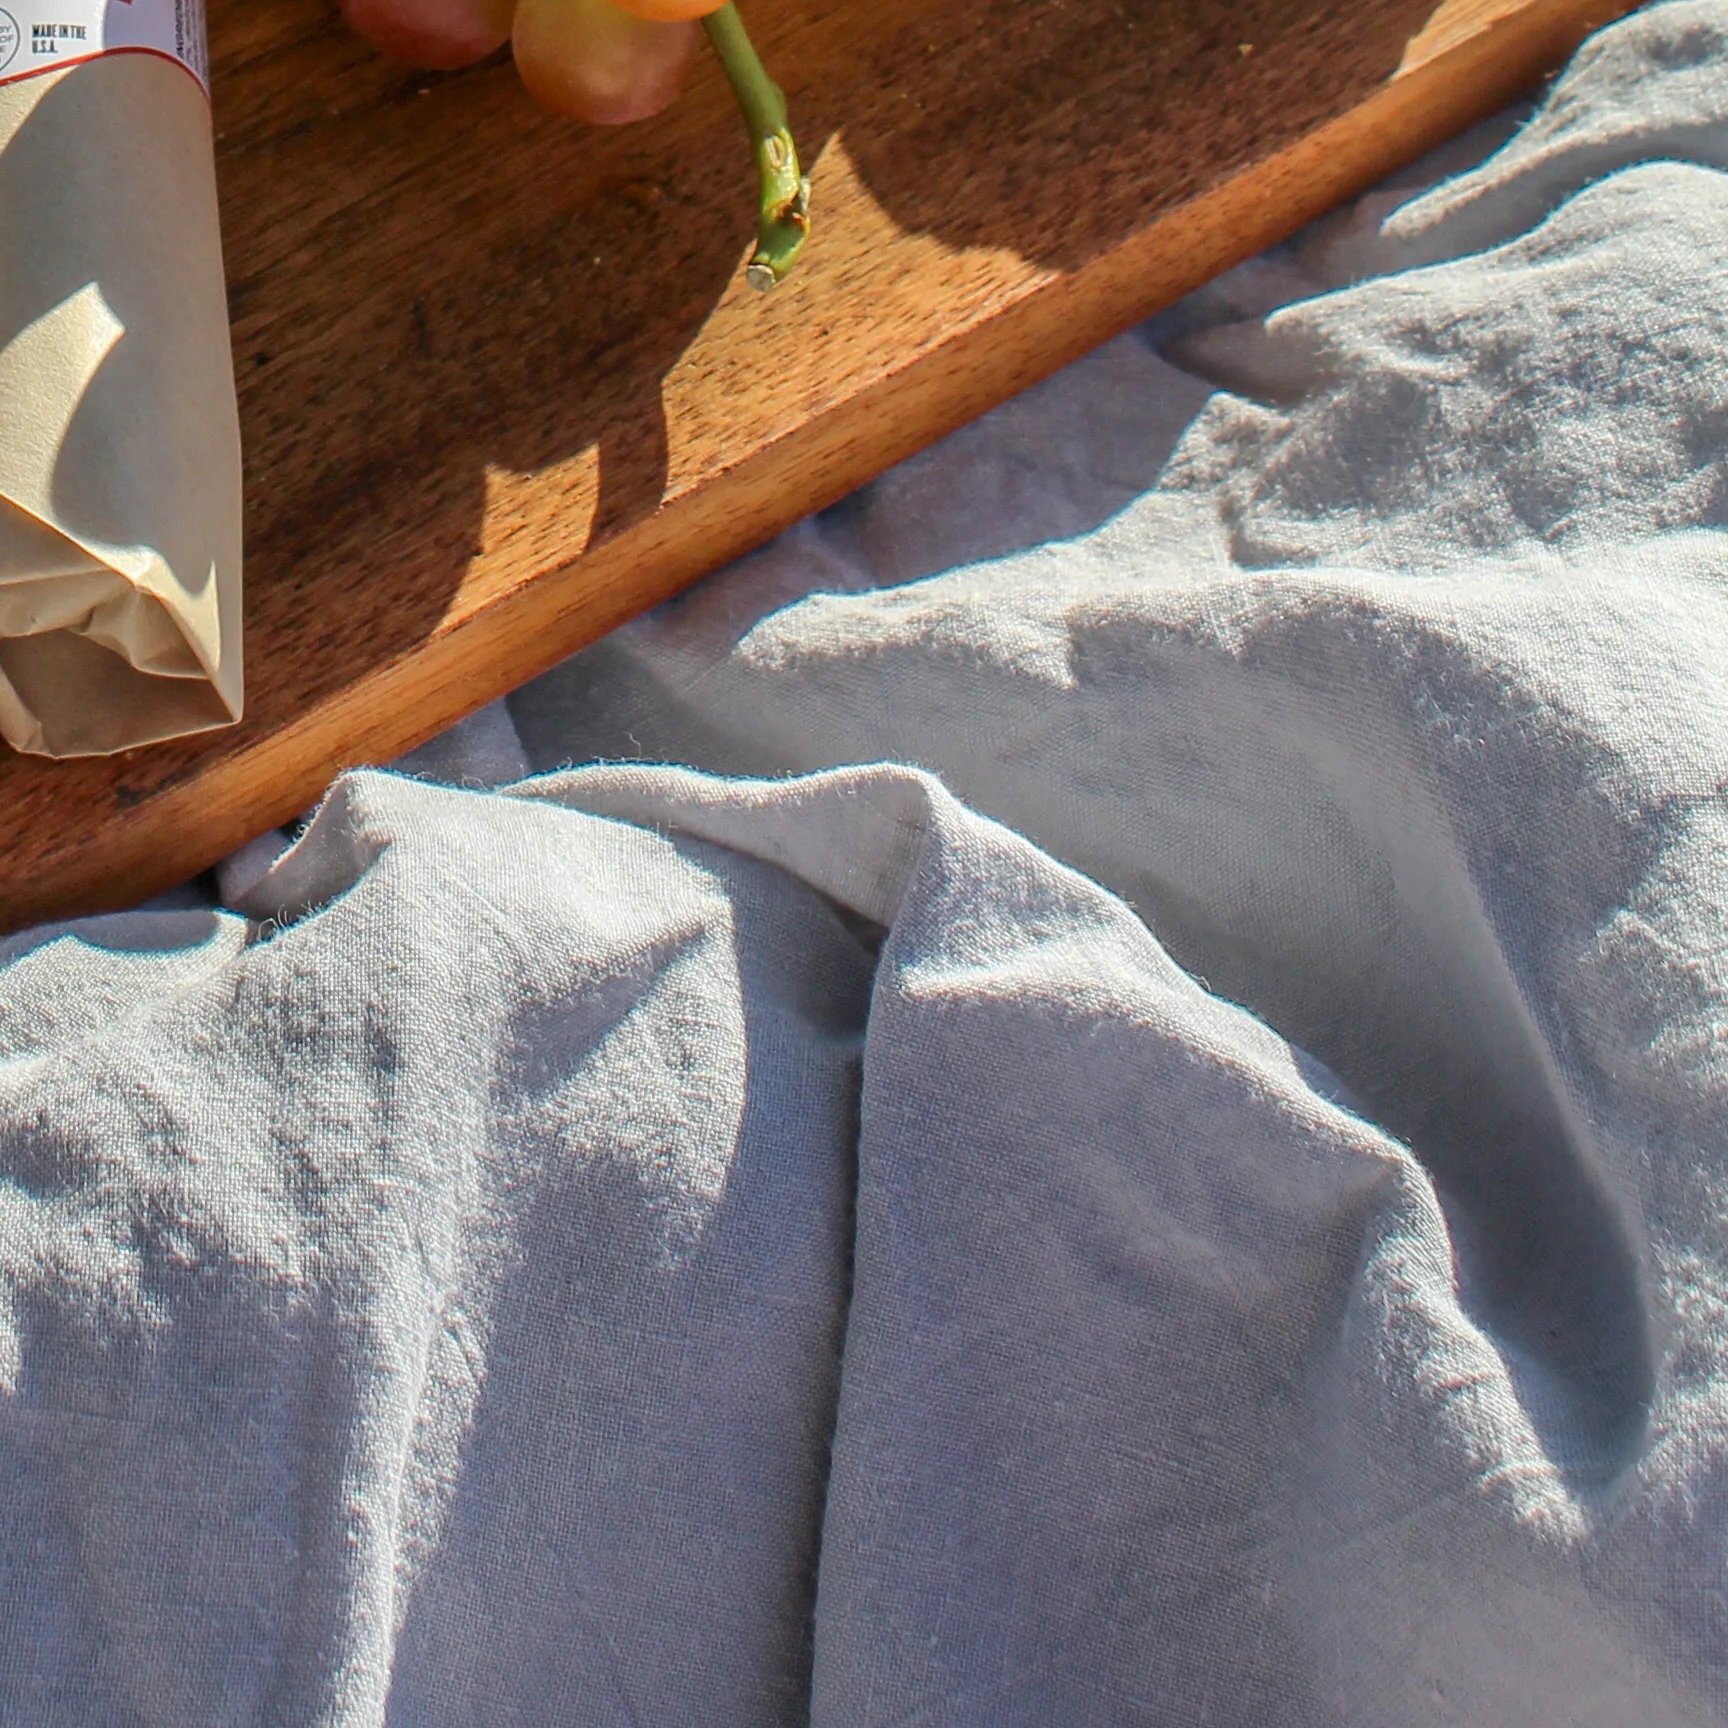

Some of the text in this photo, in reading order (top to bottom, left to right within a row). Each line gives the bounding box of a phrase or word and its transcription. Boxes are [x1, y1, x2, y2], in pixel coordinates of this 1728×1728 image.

[31, 23, 87, 41] MADE IN THE
[31, 40, 59, 54] U.S.A.
